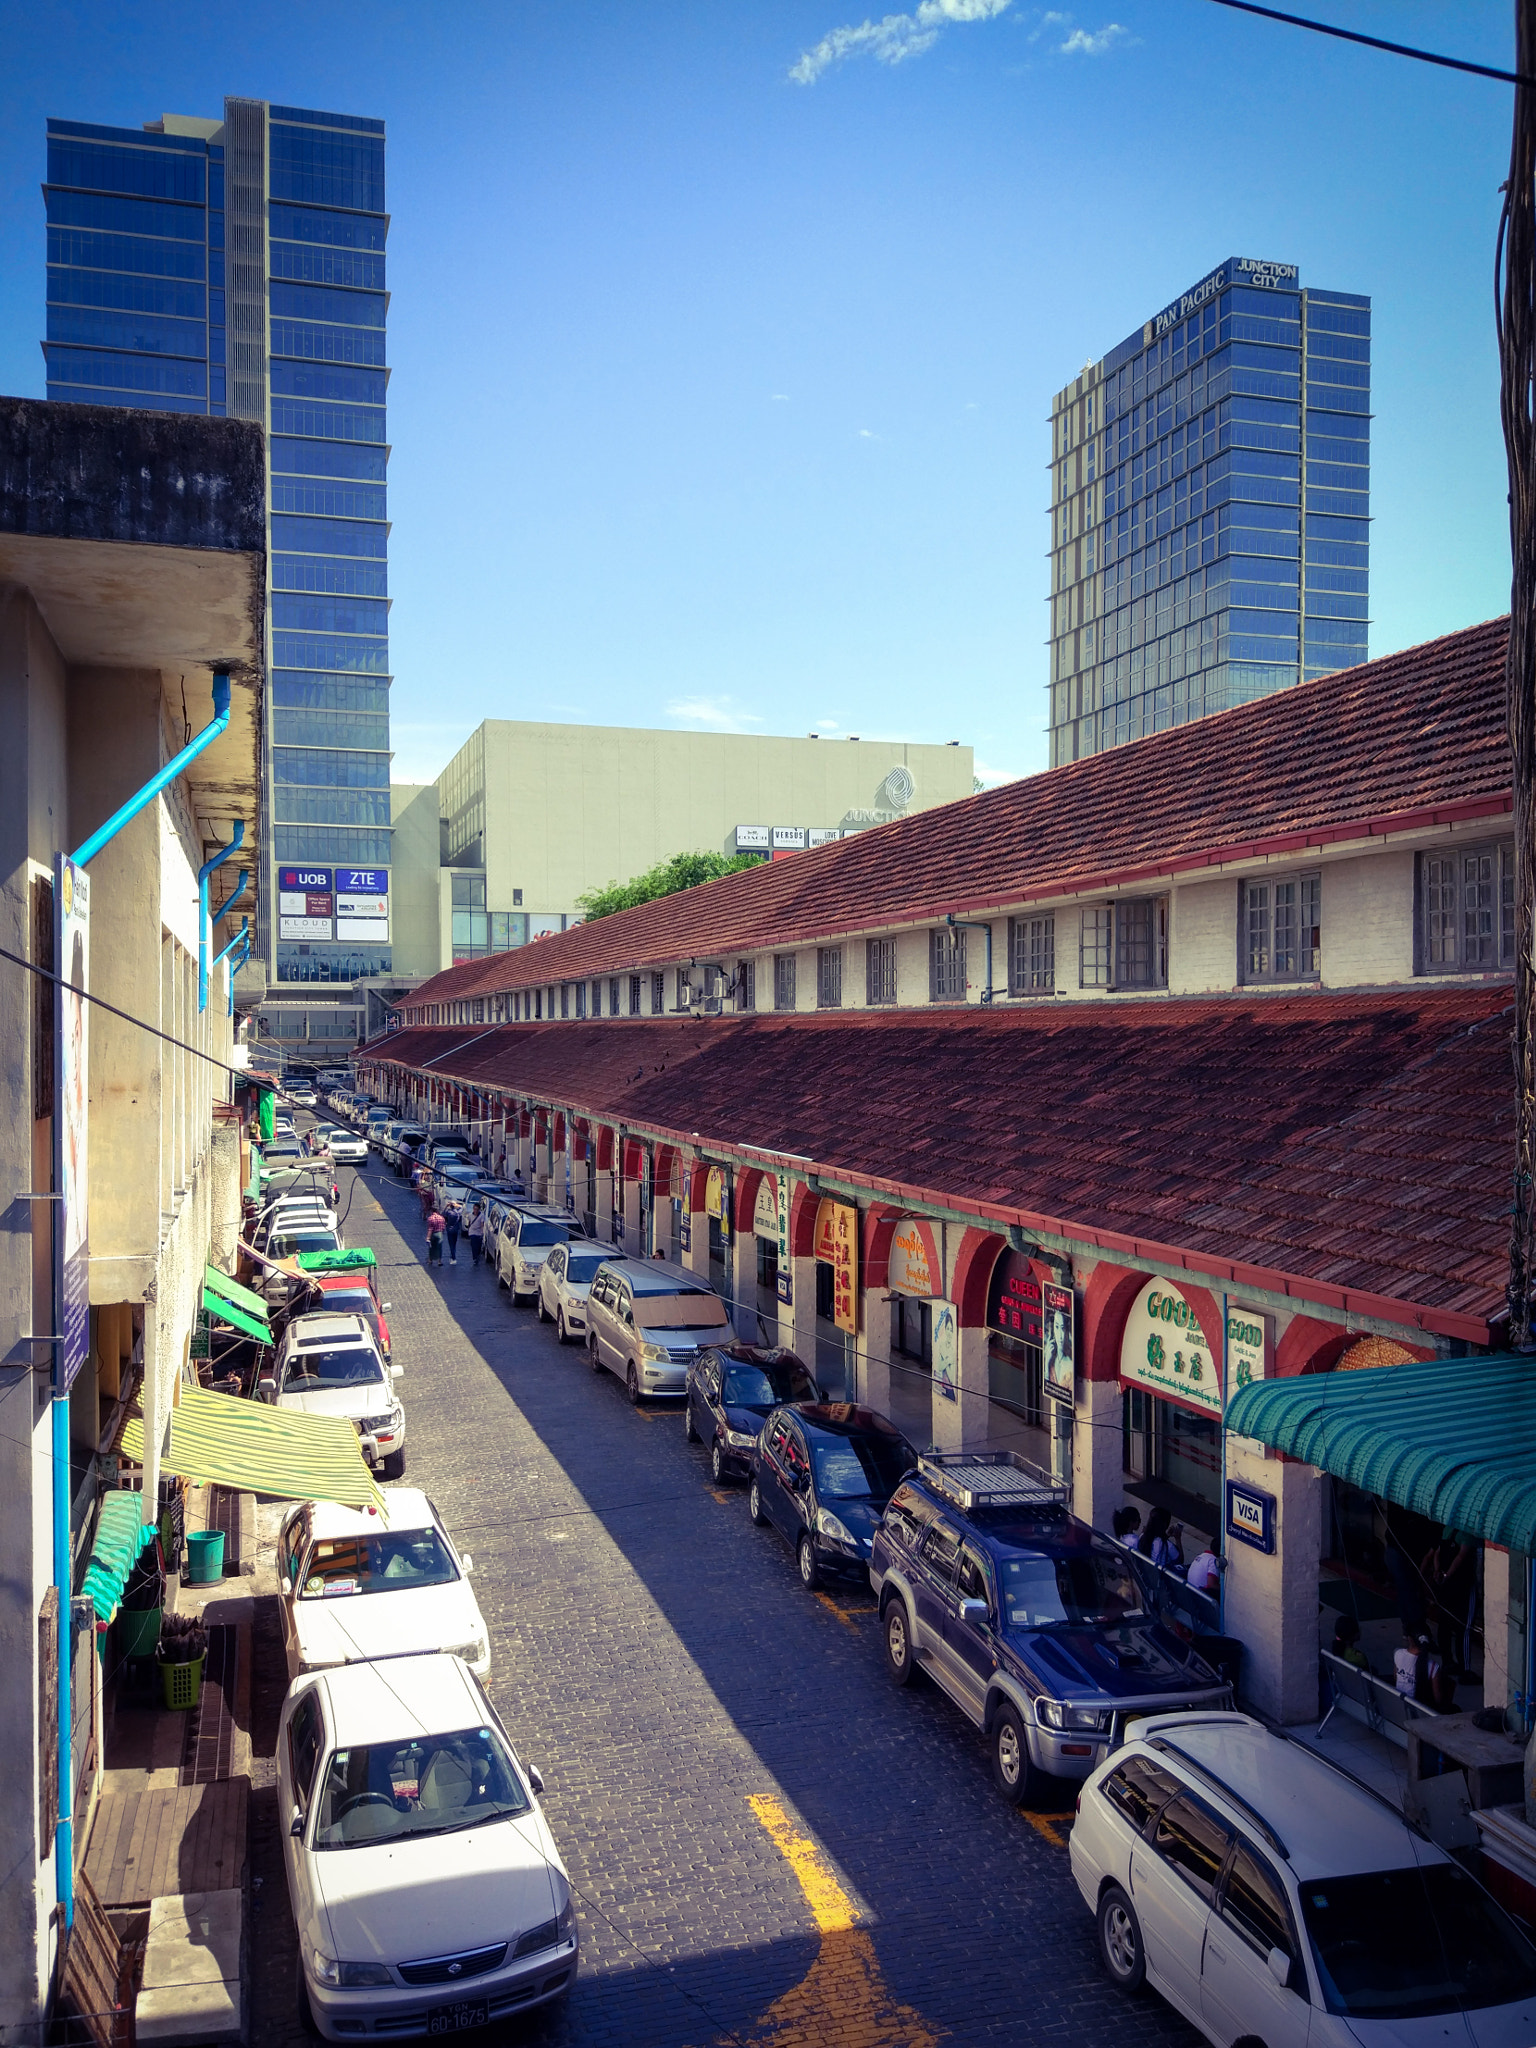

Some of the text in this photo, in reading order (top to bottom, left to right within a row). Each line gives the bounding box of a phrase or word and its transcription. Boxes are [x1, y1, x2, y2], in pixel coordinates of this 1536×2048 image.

[1237, 258, 1297, 278] JUNCTION
[1251, 273, 1281, 288] CITY
[1155, 270, 1225, 335] PAN PACIFIC
[775, 831, 803, 839] VERSUS
[298, 873, 327, 885] UOB
[349, 871, 375, 885] ZTE
[1147, 1291, 1201, 1332] GOOD
[1227, 1318, 1263, 1348] GOOD
[1237, 1501, 1259, 1524] VISA
[448, 2002, 469, 2013] YGN
